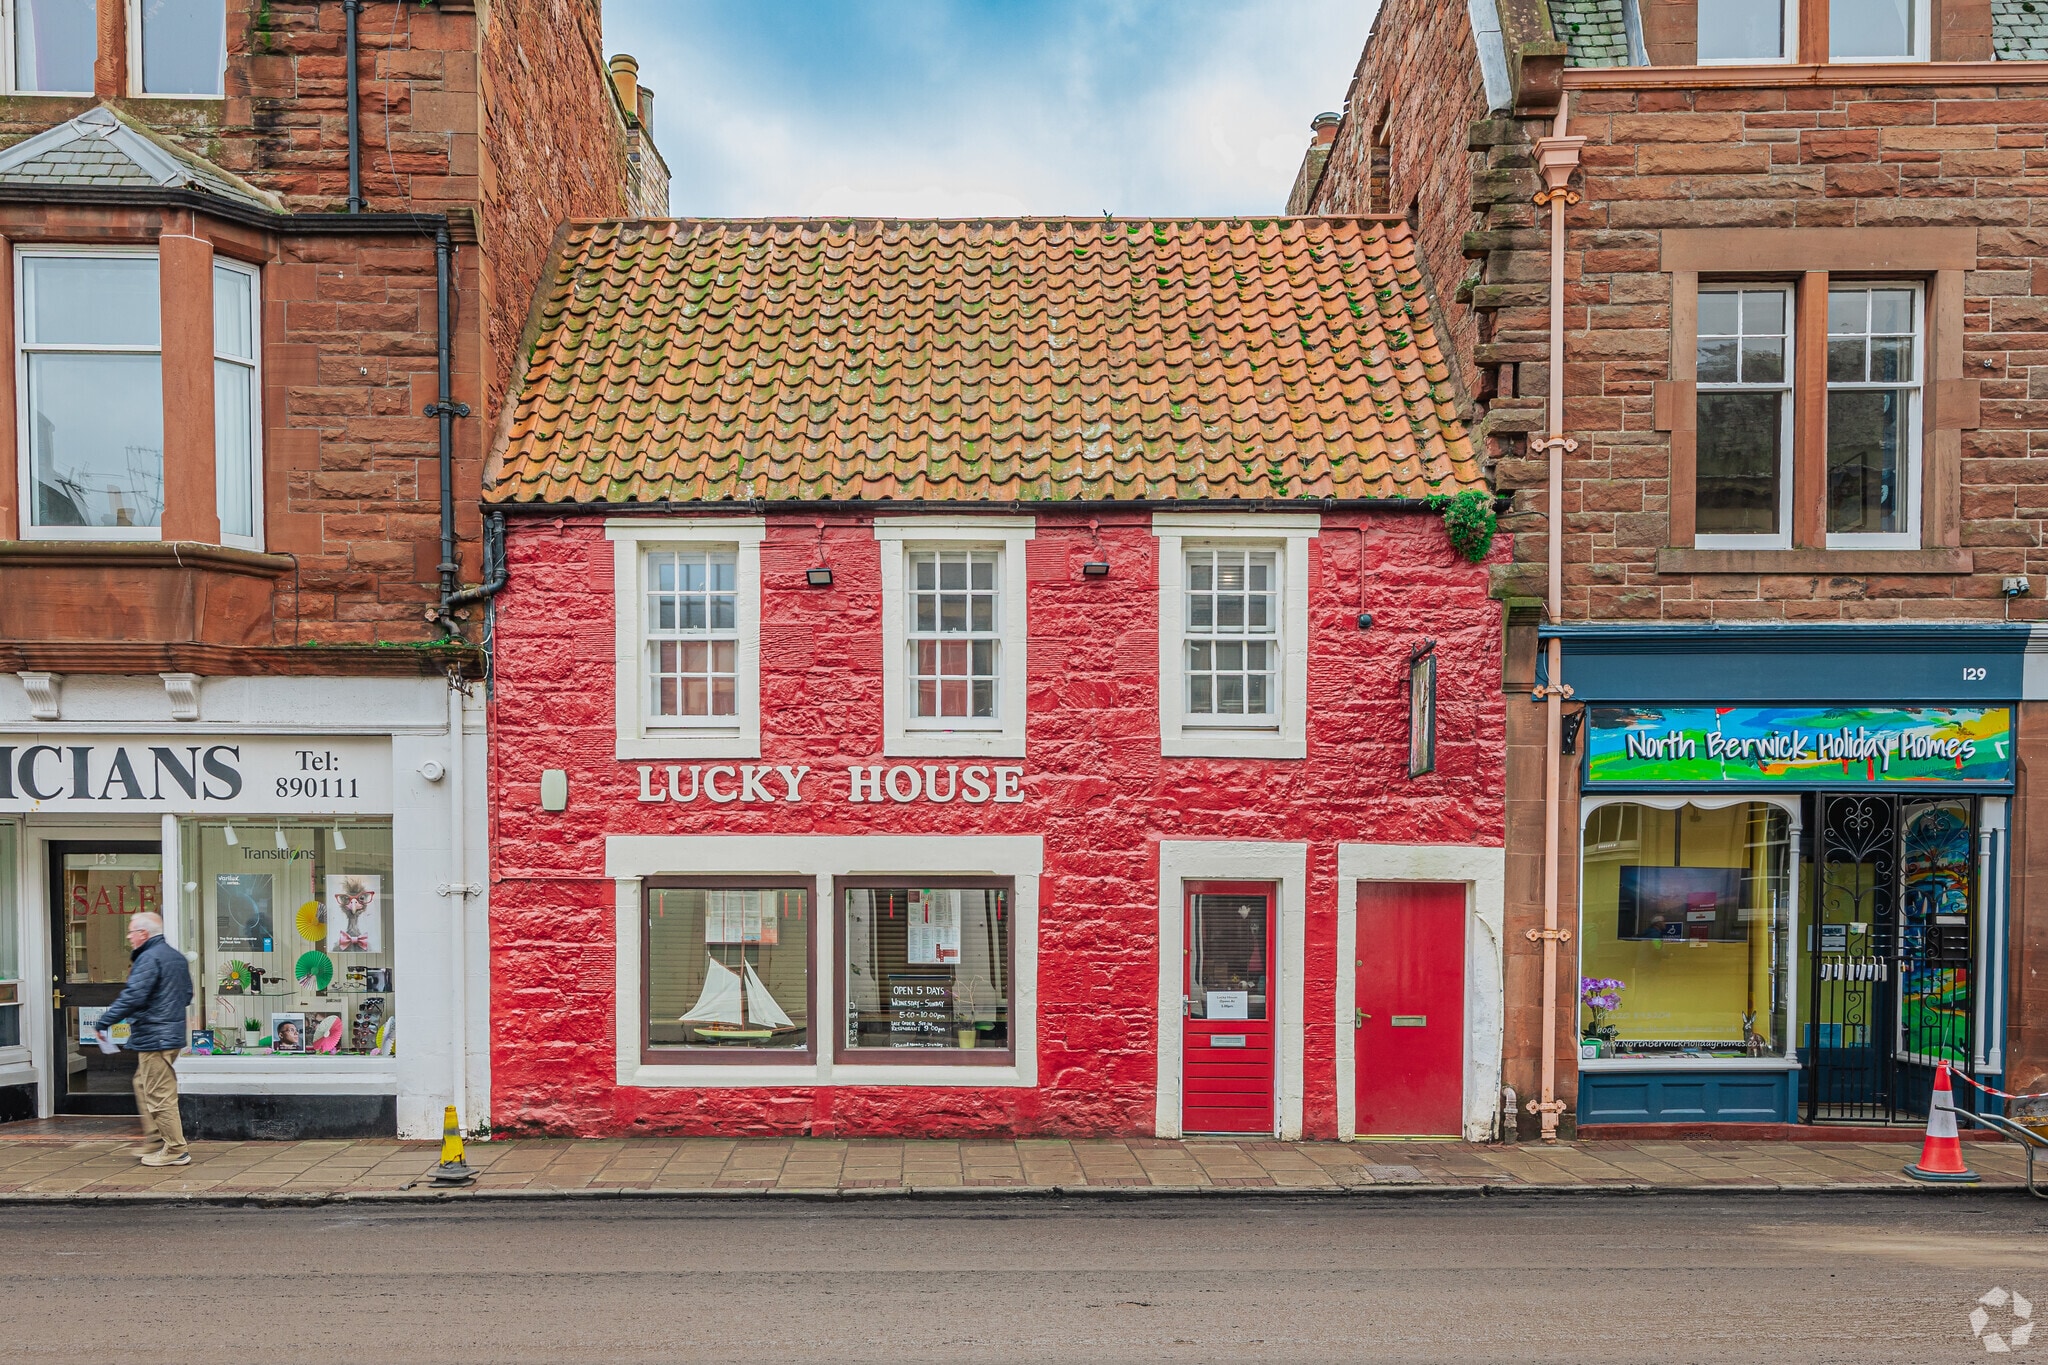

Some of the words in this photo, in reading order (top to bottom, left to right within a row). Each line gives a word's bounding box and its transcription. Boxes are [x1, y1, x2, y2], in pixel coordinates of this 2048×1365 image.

[1963, 667, 1987, 680] 129
[1625, 730, 1697, 759] North
[1704, 729, 1809, 760] Berwick
[1816, 726, 1891, 772] Holiday
[1898, 732, 1976, 760] Homes
[295, 750, 338, 771] Tel:
[275, 777, 359, 798] 890111
[636, 765, 810, 802] LUCKY
[847, 765, 1025, 803] HOUSE
[95, 853, 118, 865] 123
[241, 845, 316, 861] Transitions
[73, 885, 158, 916] SALE
[893, 986, 913, 995] OPEN
[916, 986, 923, 995] 5
[926, 986, 945, 995] DAYS
